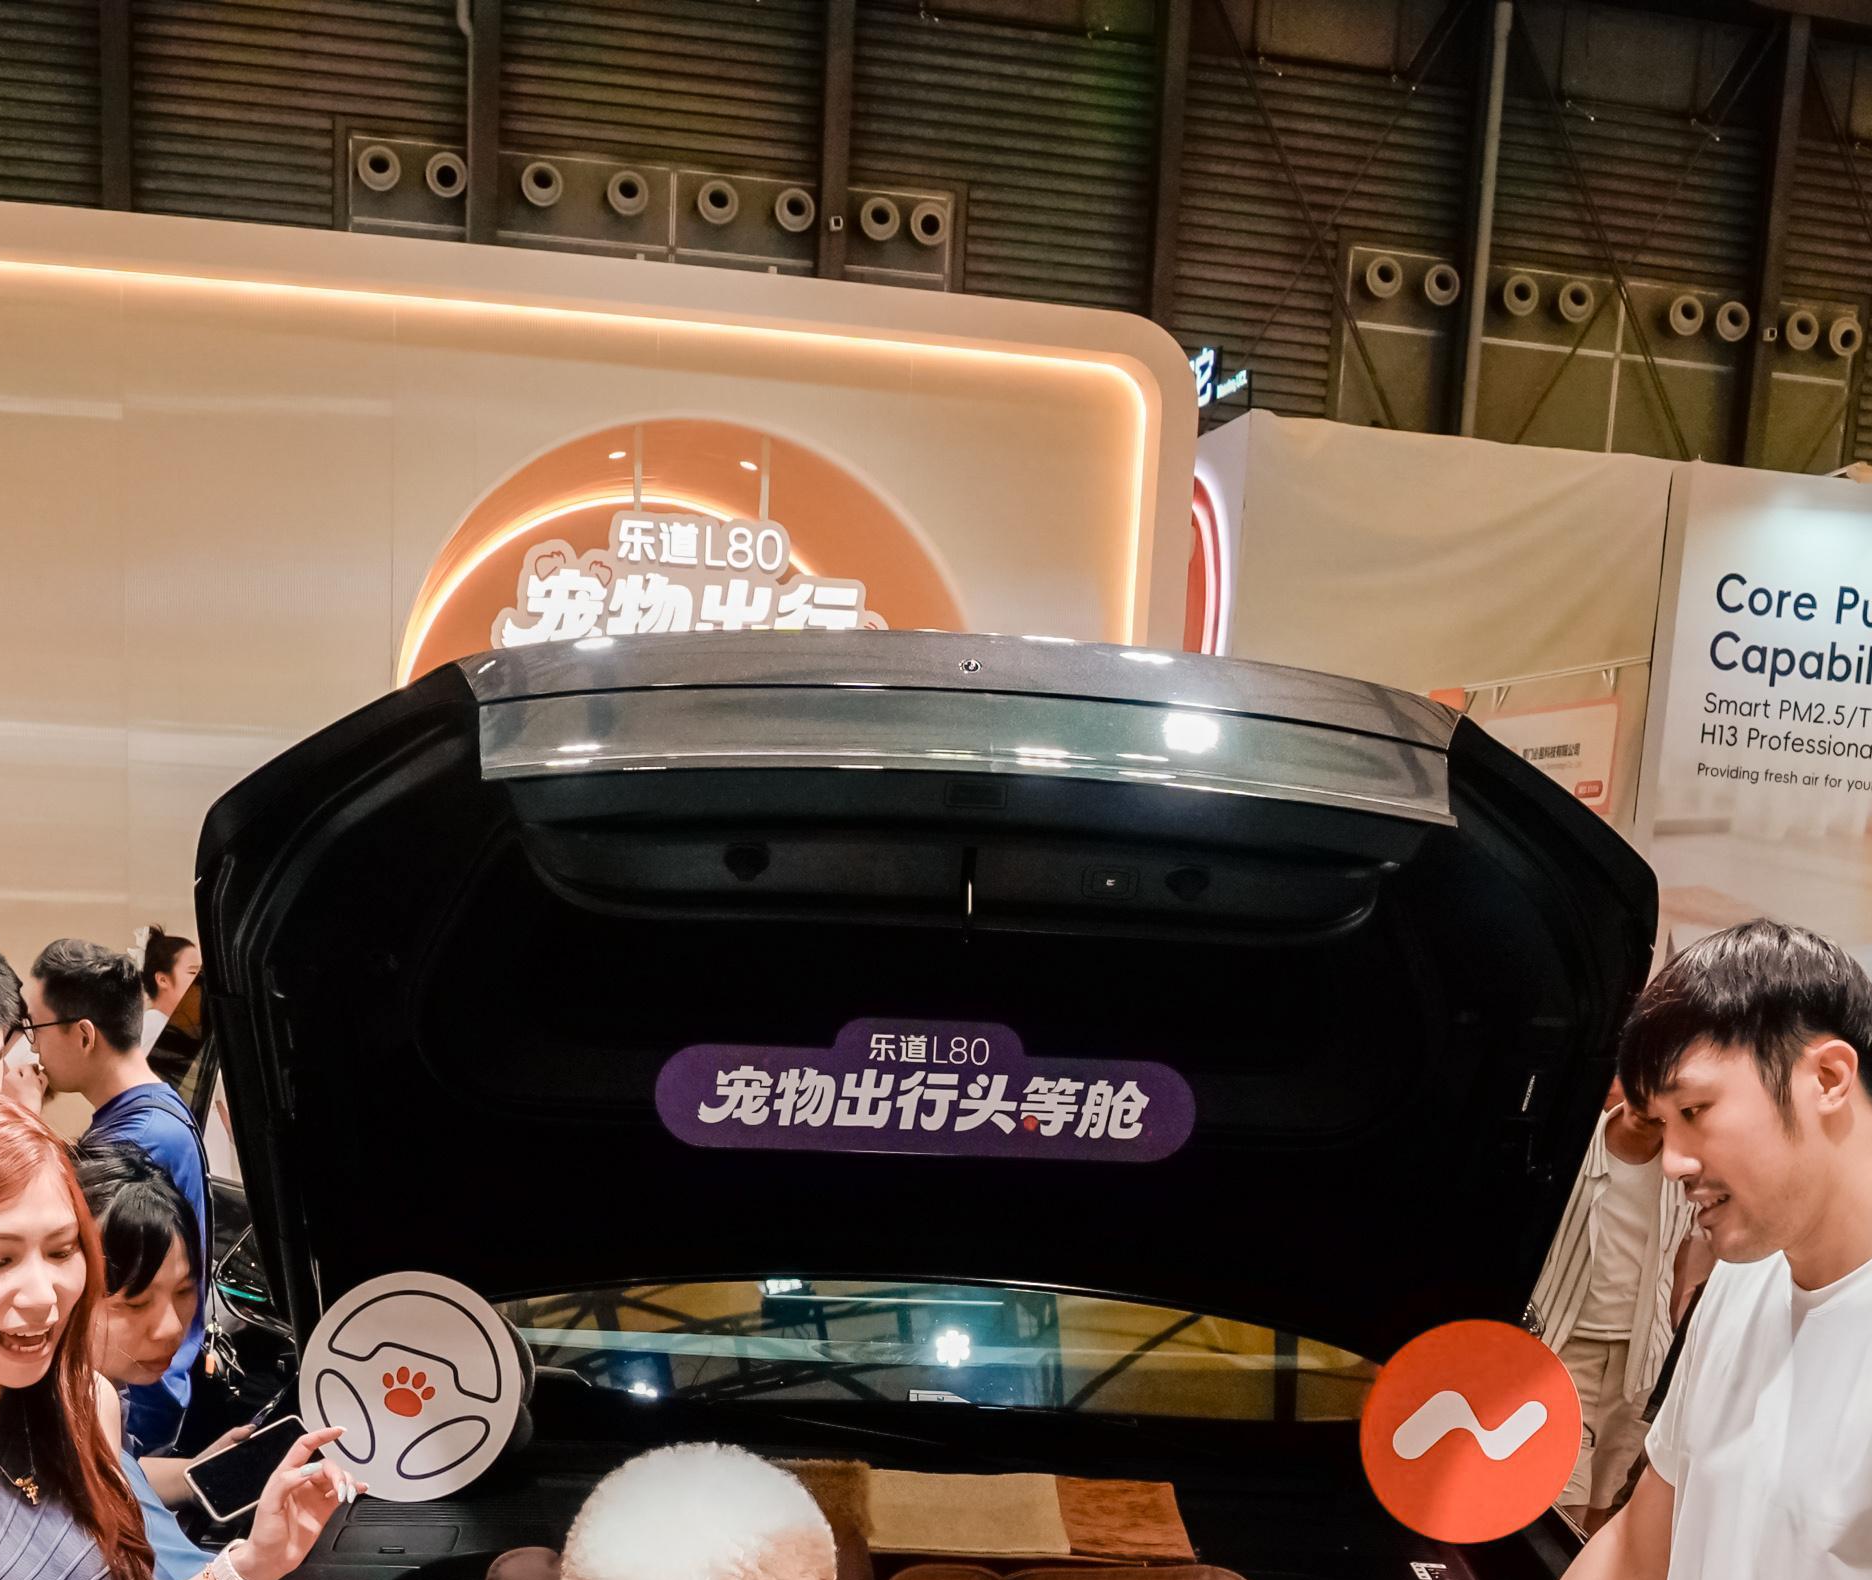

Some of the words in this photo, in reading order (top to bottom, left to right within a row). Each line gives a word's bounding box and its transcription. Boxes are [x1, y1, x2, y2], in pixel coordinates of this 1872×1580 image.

[617, 519, 784, 573] 乐道L80
[1715, 572, 1817, 622] Core
[1704, 692, 1771, 721] Smart
[1700, 722, 1739, 748] H13
[1697, 762, 1760, 786] Providing
[1763, 768, 1799, 787] fresh
[1801, 772, 1820, 788] air
[1823, 773, 1843, 791] for
[868, 1033, 990, 1067] 乐道L80
[697, 1064, 1151, 1140] 宠物出行头等舱
